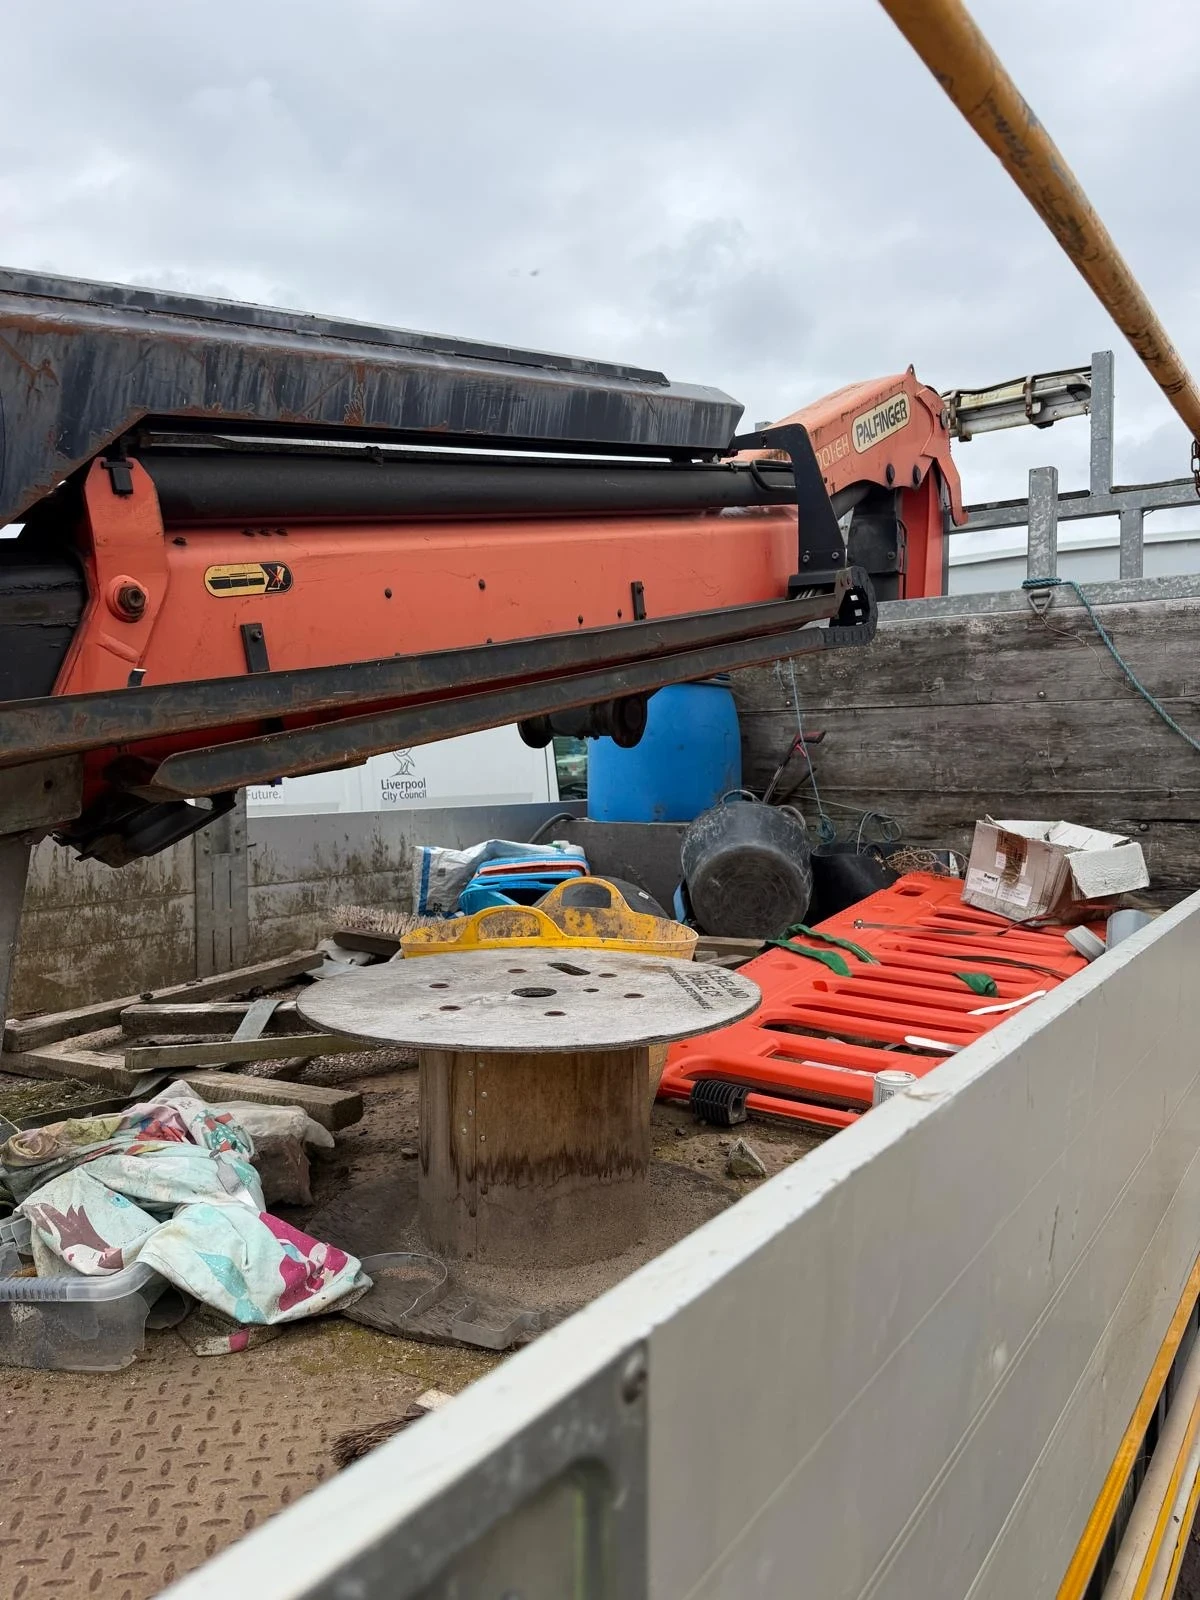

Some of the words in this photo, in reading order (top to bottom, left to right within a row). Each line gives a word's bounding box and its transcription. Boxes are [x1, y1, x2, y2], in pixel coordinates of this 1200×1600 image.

[856, 398, 907, 447] PALFINGER
[381, 777, 426, 792] Liverpool
[382, 790, 397, 803] City
[400, 789, 427, 800] Council
